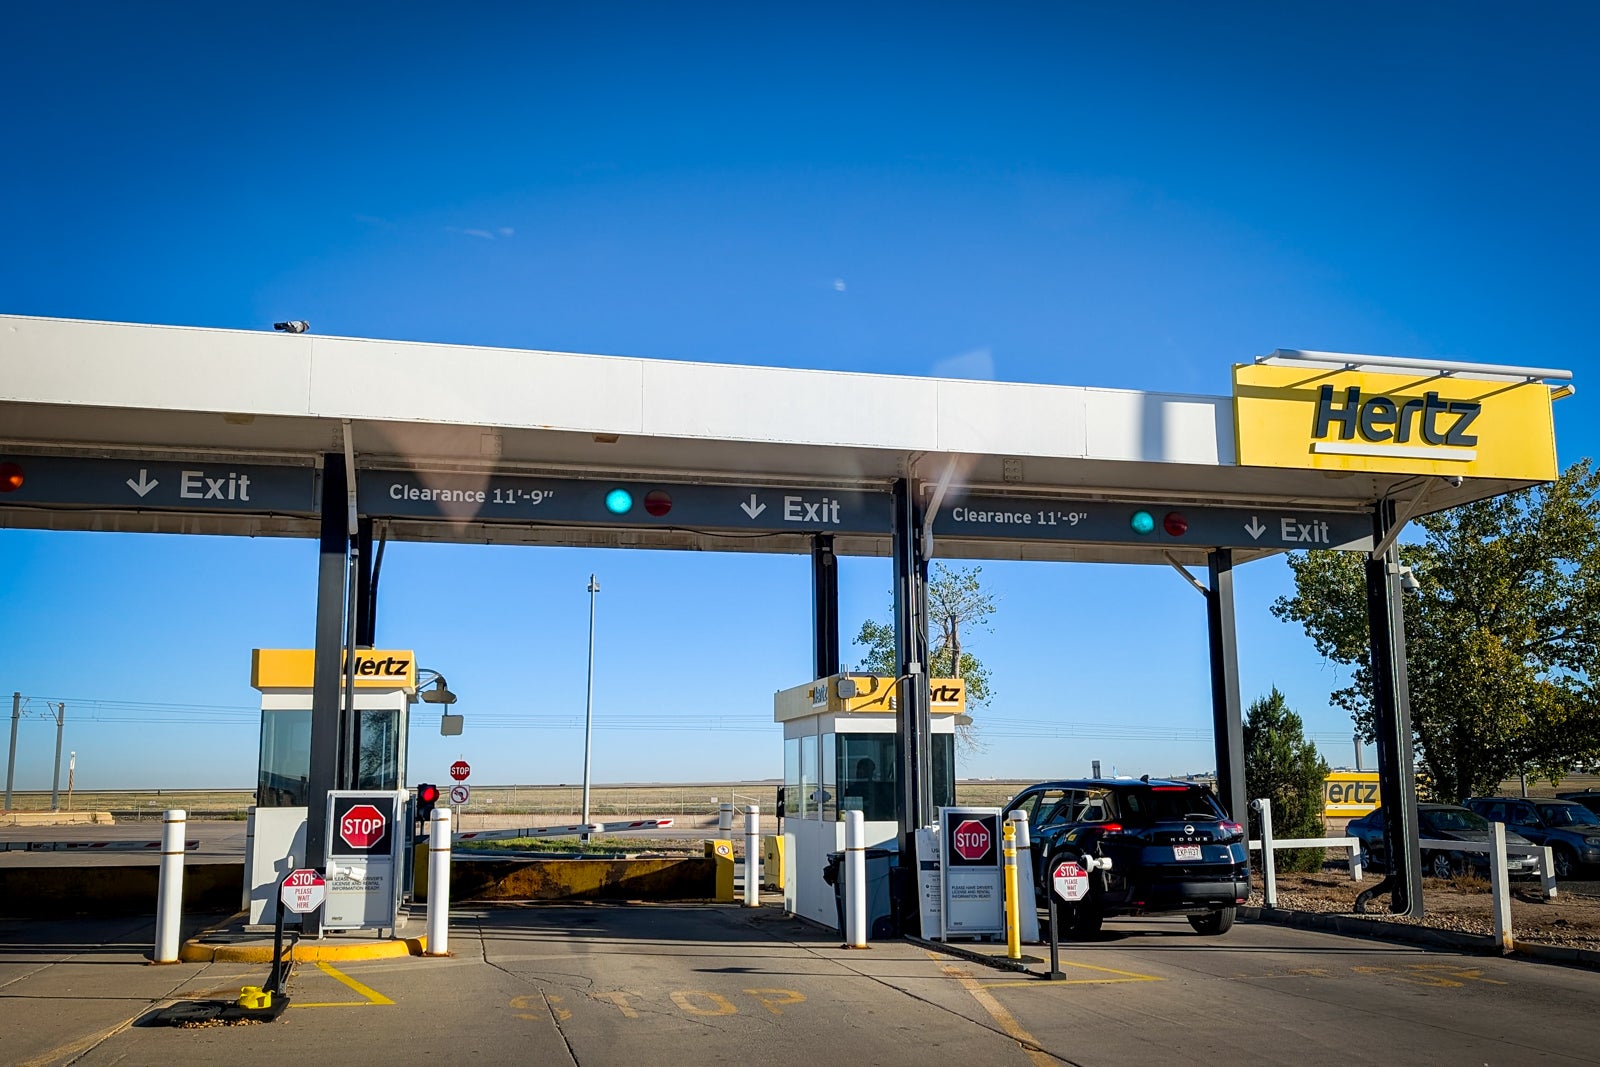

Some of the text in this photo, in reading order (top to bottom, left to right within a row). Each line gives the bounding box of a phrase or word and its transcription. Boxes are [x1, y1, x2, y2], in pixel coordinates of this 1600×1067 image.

[1312, 384, 1481, 447] Hertz
[180, 470, 251, 501] Exit
[389, 484, 486, 503] Clearance
[784, 495, 840, 524] Exit
[952, 507, 1032, 524] Clearance
[1281, 517, 1330, 544] Exit
[929, 684, 961, 702] rtz
[451, 766, 470, 775] STOP
[1324, 781, 1378, 804] ertz
[343, 818, 382, 835] STOP
[957, 832, 988, 848] STOP
[292, 873, 317, 886] STOP
[1060, 865, 1080, 877] STOP
[294, 887, 313, 895] PLEASE
[296, 894, 310, 902] WAIT
[296, 901, 310, 909] HERE
